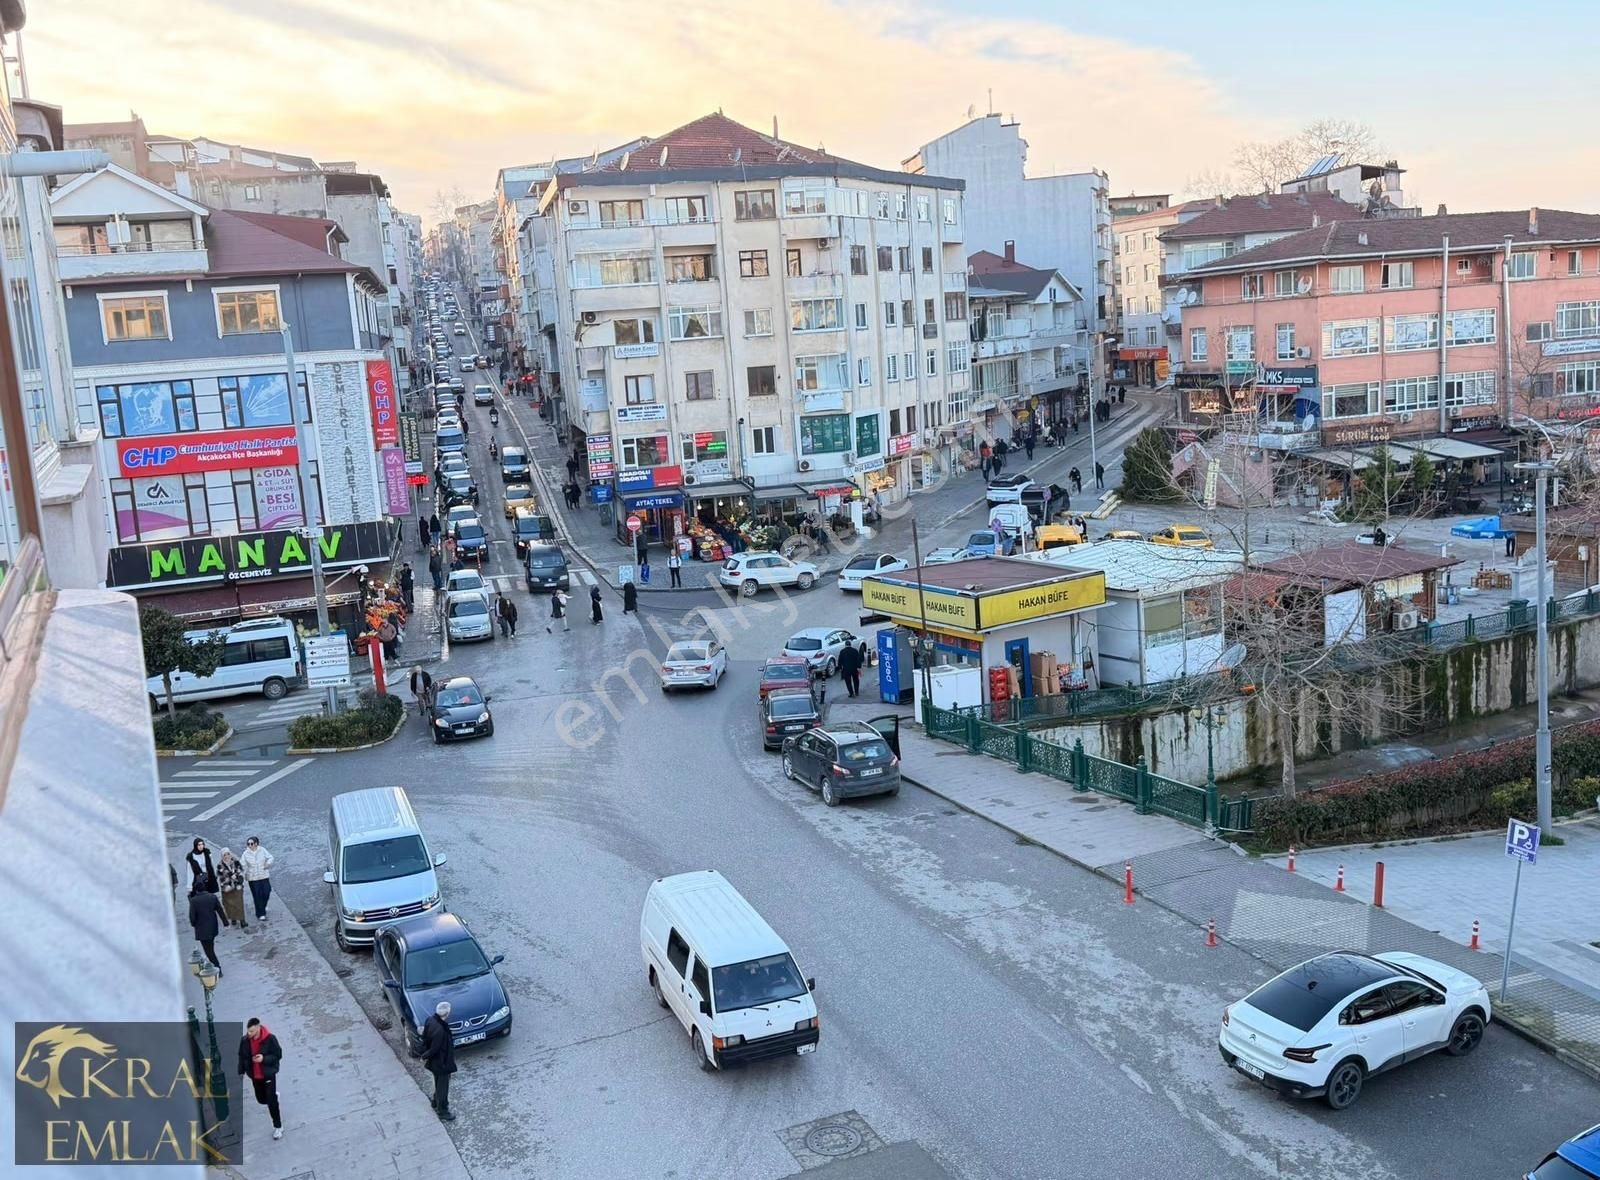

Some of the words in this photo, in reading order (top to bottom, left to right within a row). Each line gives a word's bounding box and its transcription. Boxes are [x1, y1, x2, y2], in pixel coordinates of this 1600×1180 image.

[1265, 371, 1283, 384] MKS
[373, 380, 390, 424] CHP
[179, 440, 240, 454] Cumhuriyet
[240, 439, 263, 451] Halk
[401, 416, 411, 462] Fizyoterapi
[409, 417, 420, 460] Fitoterapi
[123, 445, 177, 468] CHP
[197, 452, 232, 462] Akçakoca
[246, 449, 283, 458] Başkanlığı
[263, 469, 291, 478] GIDA
[619, 470, 651, 478] ANADOLU
[635, 499, 655, 507] AYTAÇ
[150, 531, 342, 578] MANAV
[871, 590, 890, 602] HAKAN
[890, 592, 907, 606] BÜFE
[1018, 596, 1046, 610] HAKAN
[1047, 590, 1069, 604] BÜFE
[925, 600, 947, 613] HAKAN
[948, 603, 966, 617] BÜFE
[883, 651, 893, 683] pepsi
[1512, 824, 1529, 845] P
